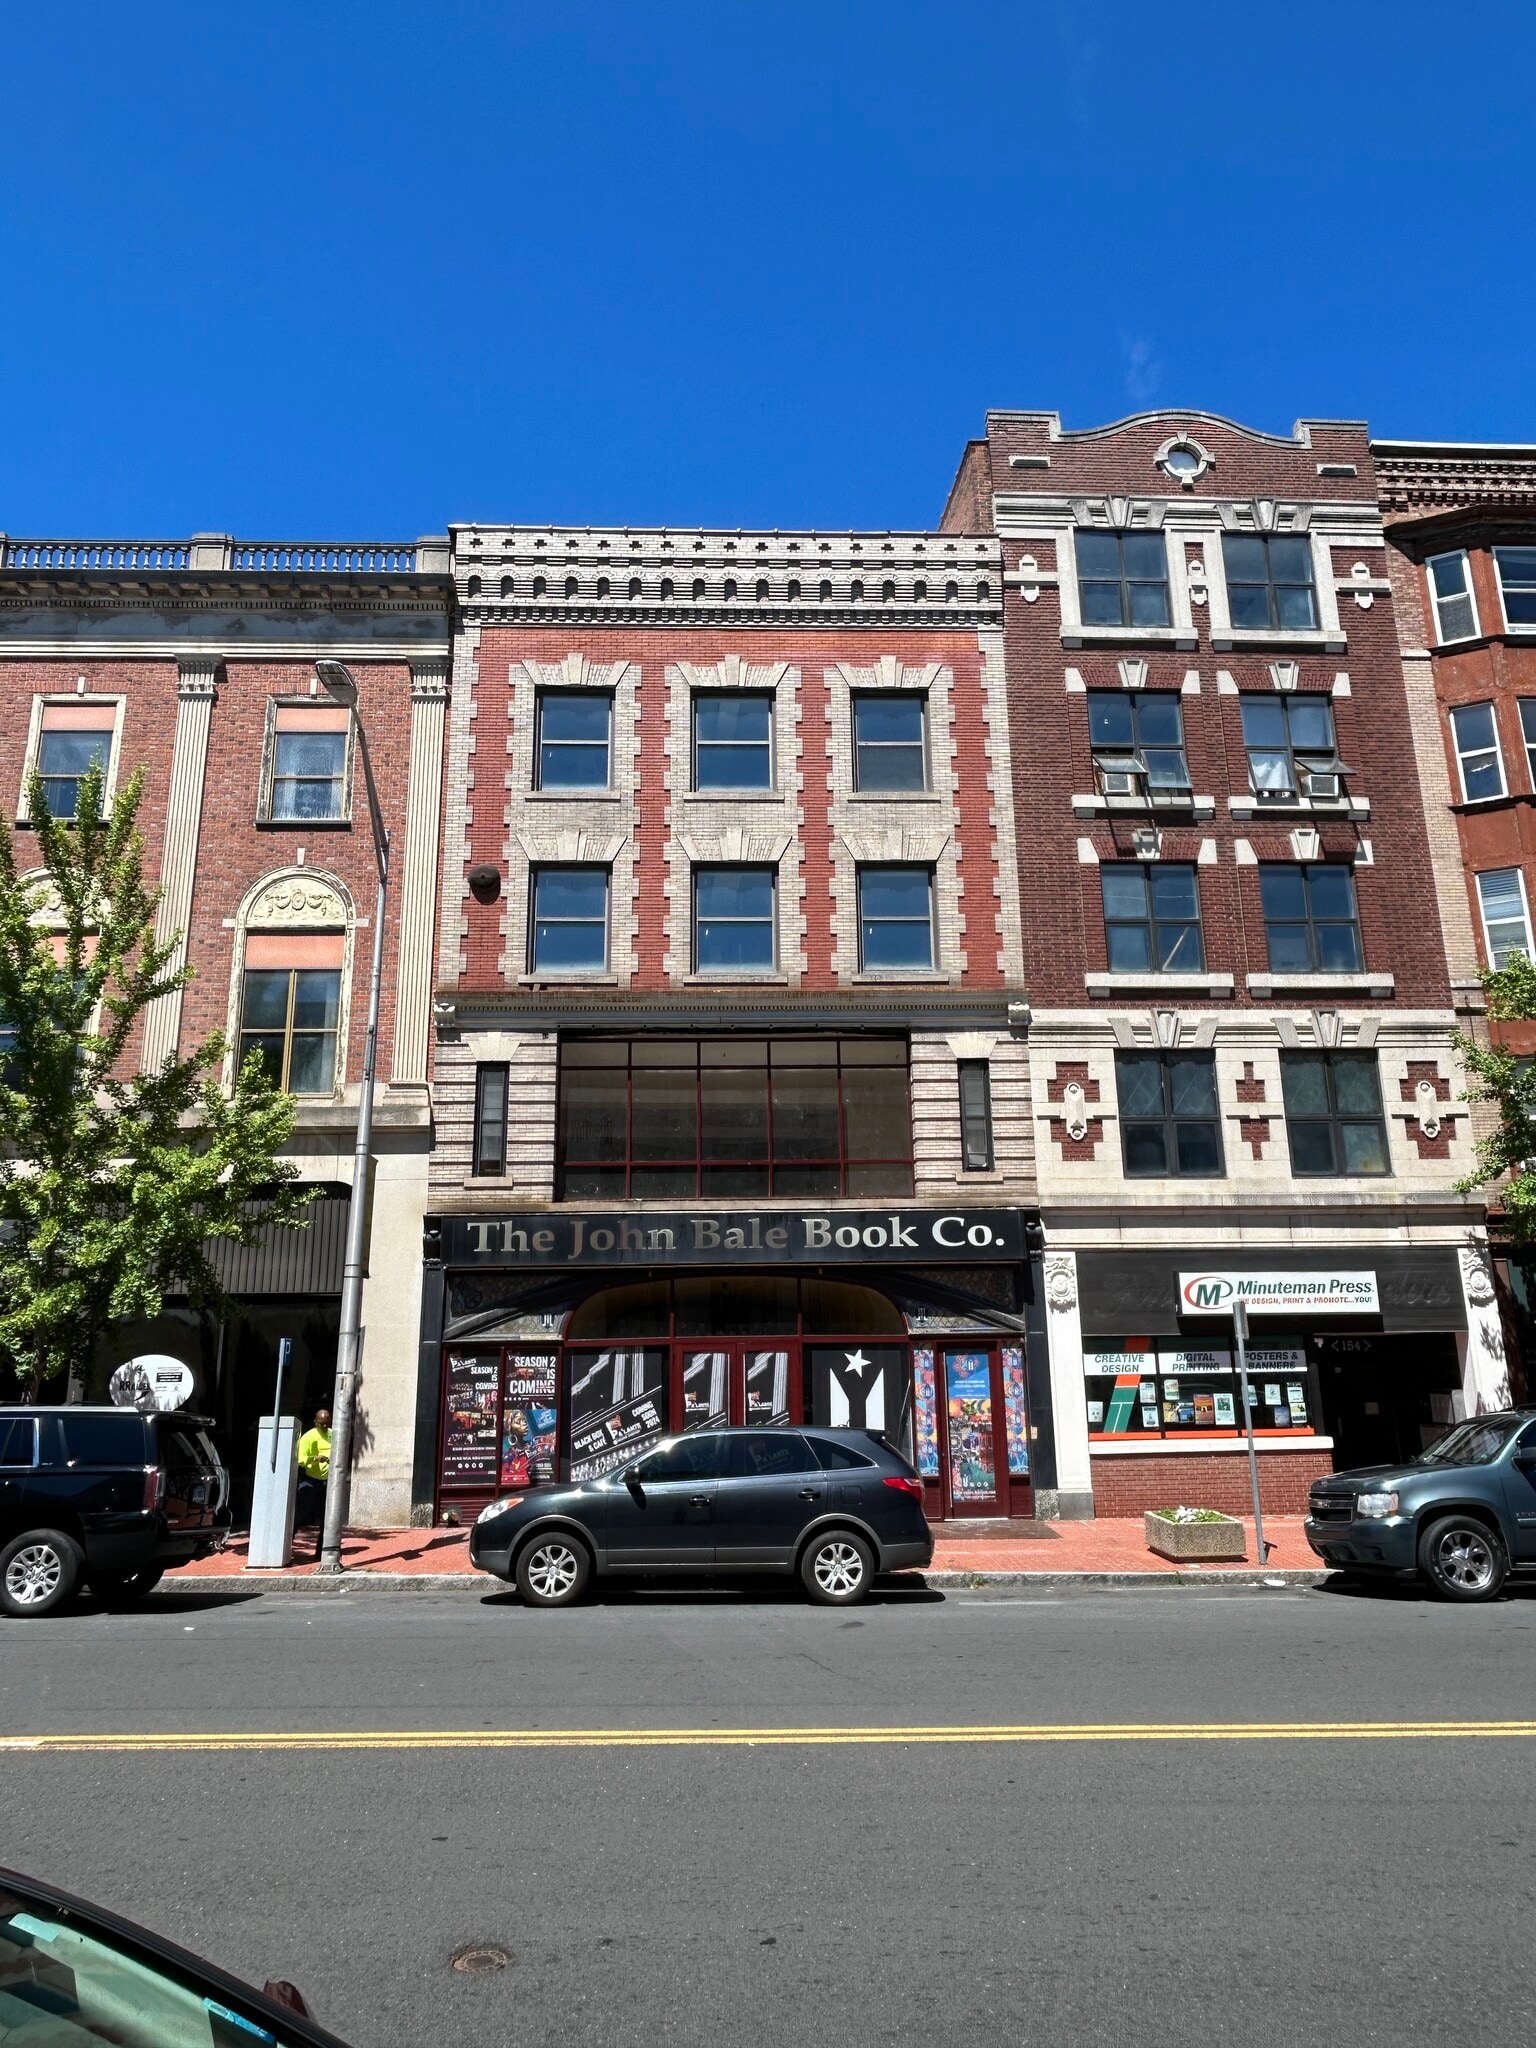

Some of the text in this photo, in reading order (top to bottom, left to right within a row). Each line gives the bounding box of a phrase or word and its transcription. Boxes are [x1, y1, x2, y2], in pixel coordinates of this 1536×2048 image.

[467, 1216, 1005, 1260] The John Bale Book Co.
[1237, 1280, 1326, 1295] Minuteman
[1094, 1353, 1145, 1363] CREATIVE
[1176, 1353, 1215, 1362] DIGITAL
[1244, 1351, 1298, 1361] POSTERS &
[514, 1356, 556, 1368] SEASON 2
[1172, 1362, 1220, 1372] PRINTING
[1247, 1361, 1296, 1370] BANNERS
[471, 1366, 493, 1375] SEASON
[1101, 1364, 1140, 1373] DESIGN
[546, 1368, 556, 1380] IS
[510, 1379, 556, 1394] COMING
[573, 1434, 592, 1450] BLACK
